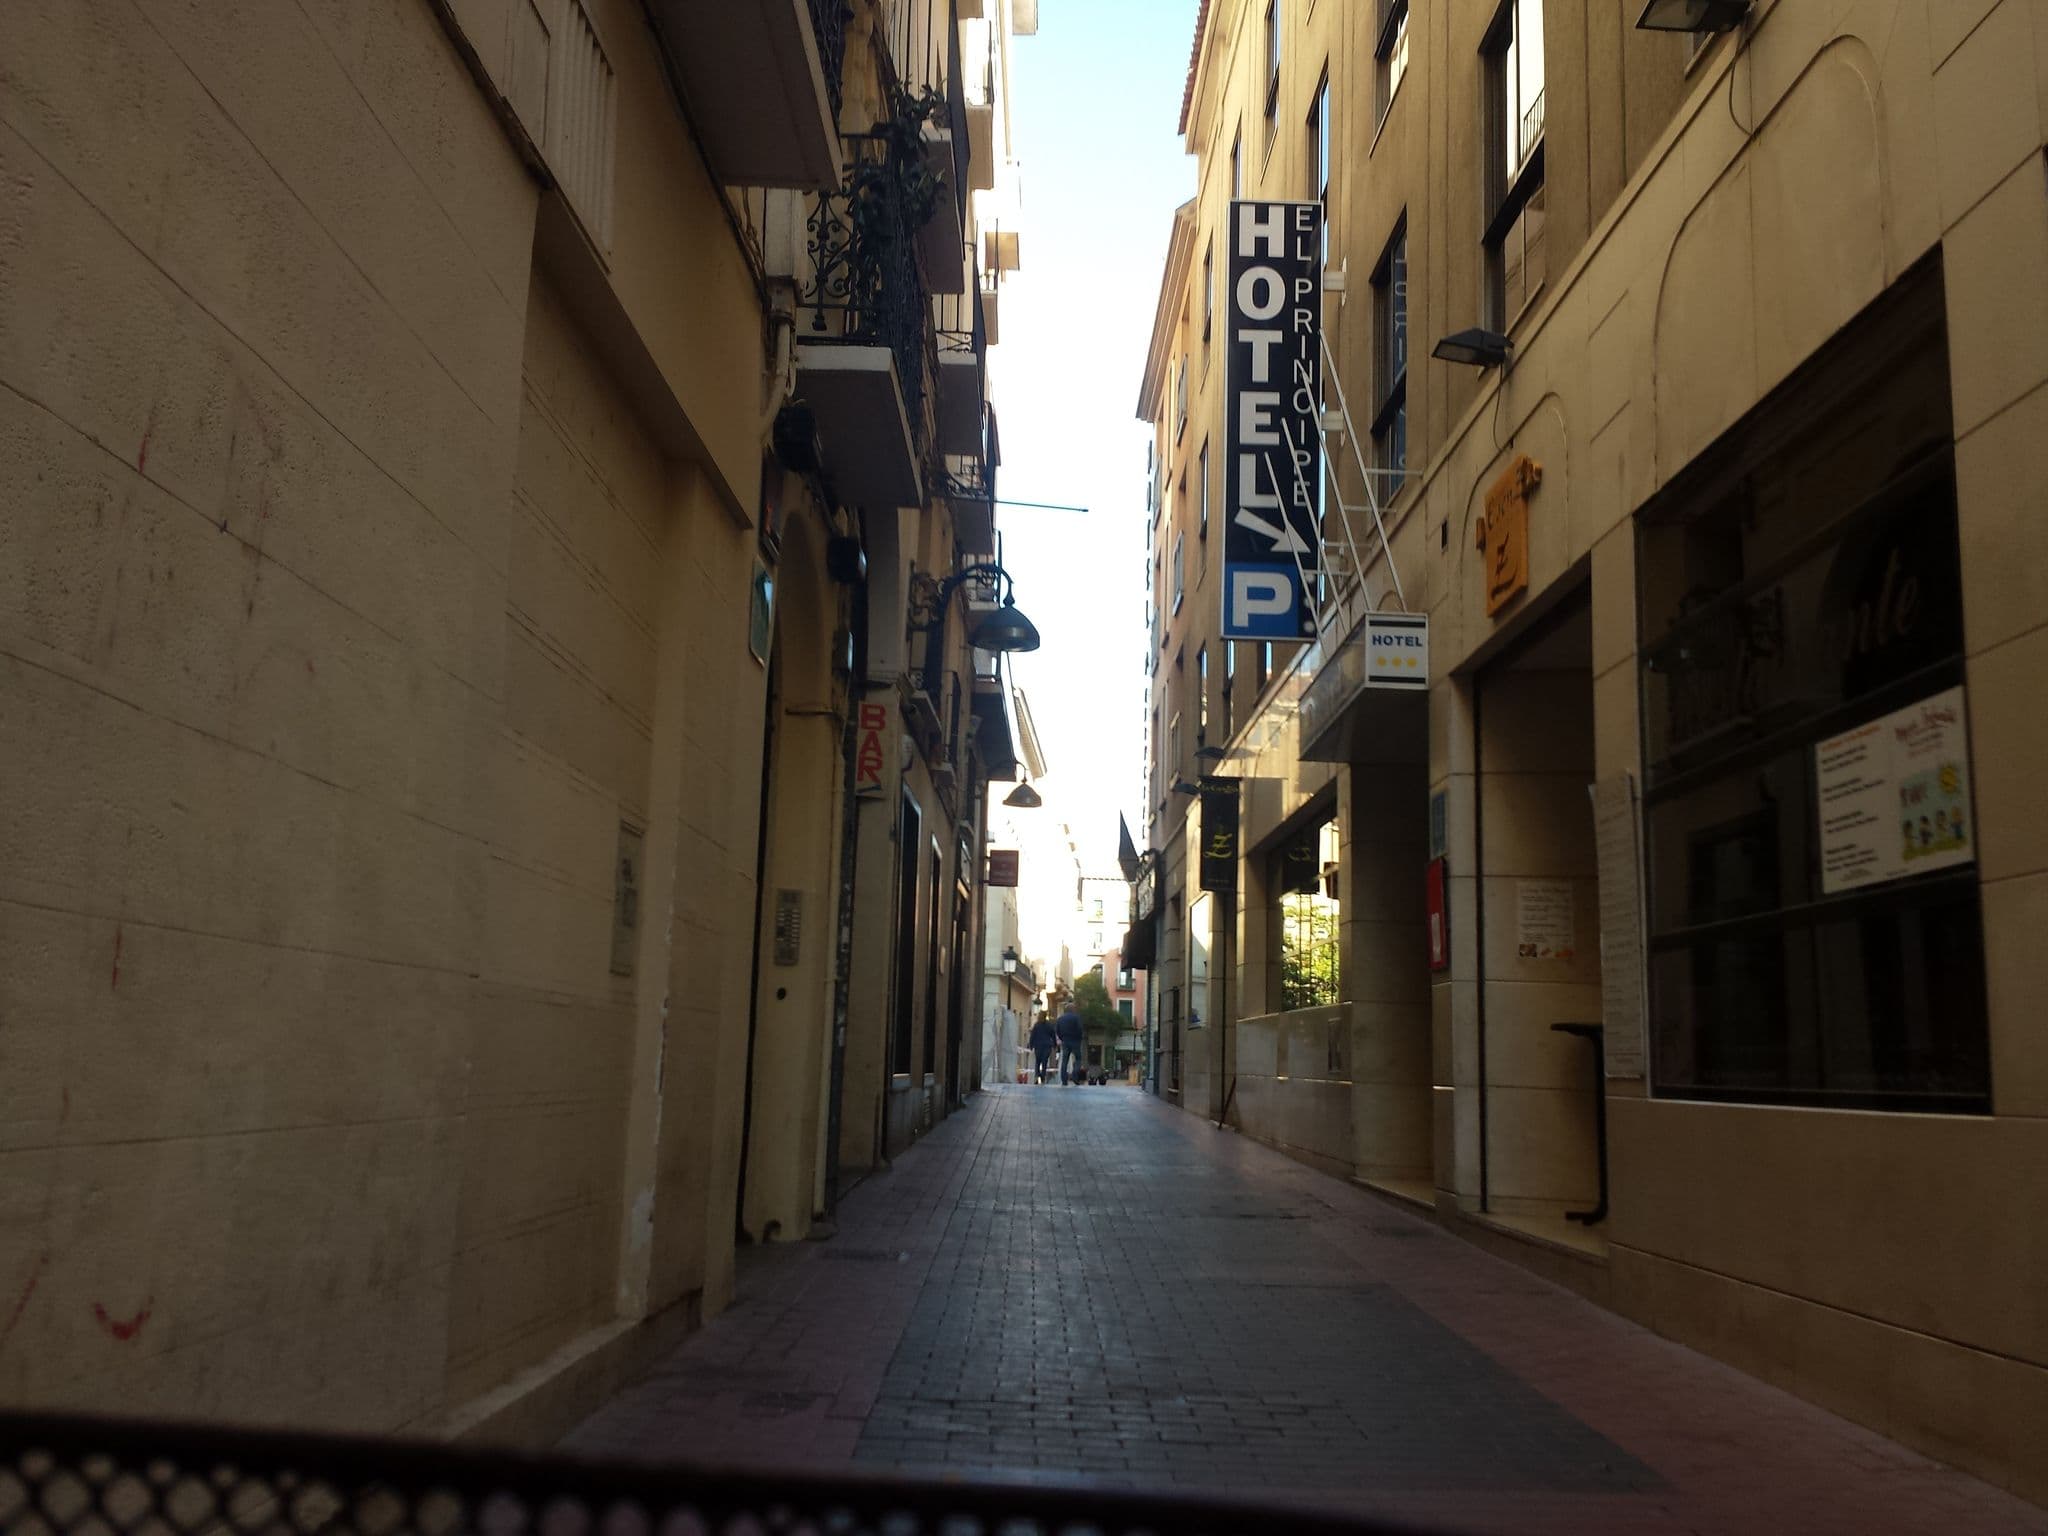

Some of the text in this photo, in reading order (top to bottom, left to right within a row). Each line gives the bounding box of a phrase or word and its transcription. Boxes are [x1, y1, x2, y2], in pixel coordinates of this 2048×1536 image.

[1236, 204, 1286, 508] HOTEL
[1292, 205, 1313, 507] EL PRINCIPE
[1232, 571, 1293, 628] P
[1372, 634, 1423, 647] HOTEL
[857, 703, 886, 785] BAR
